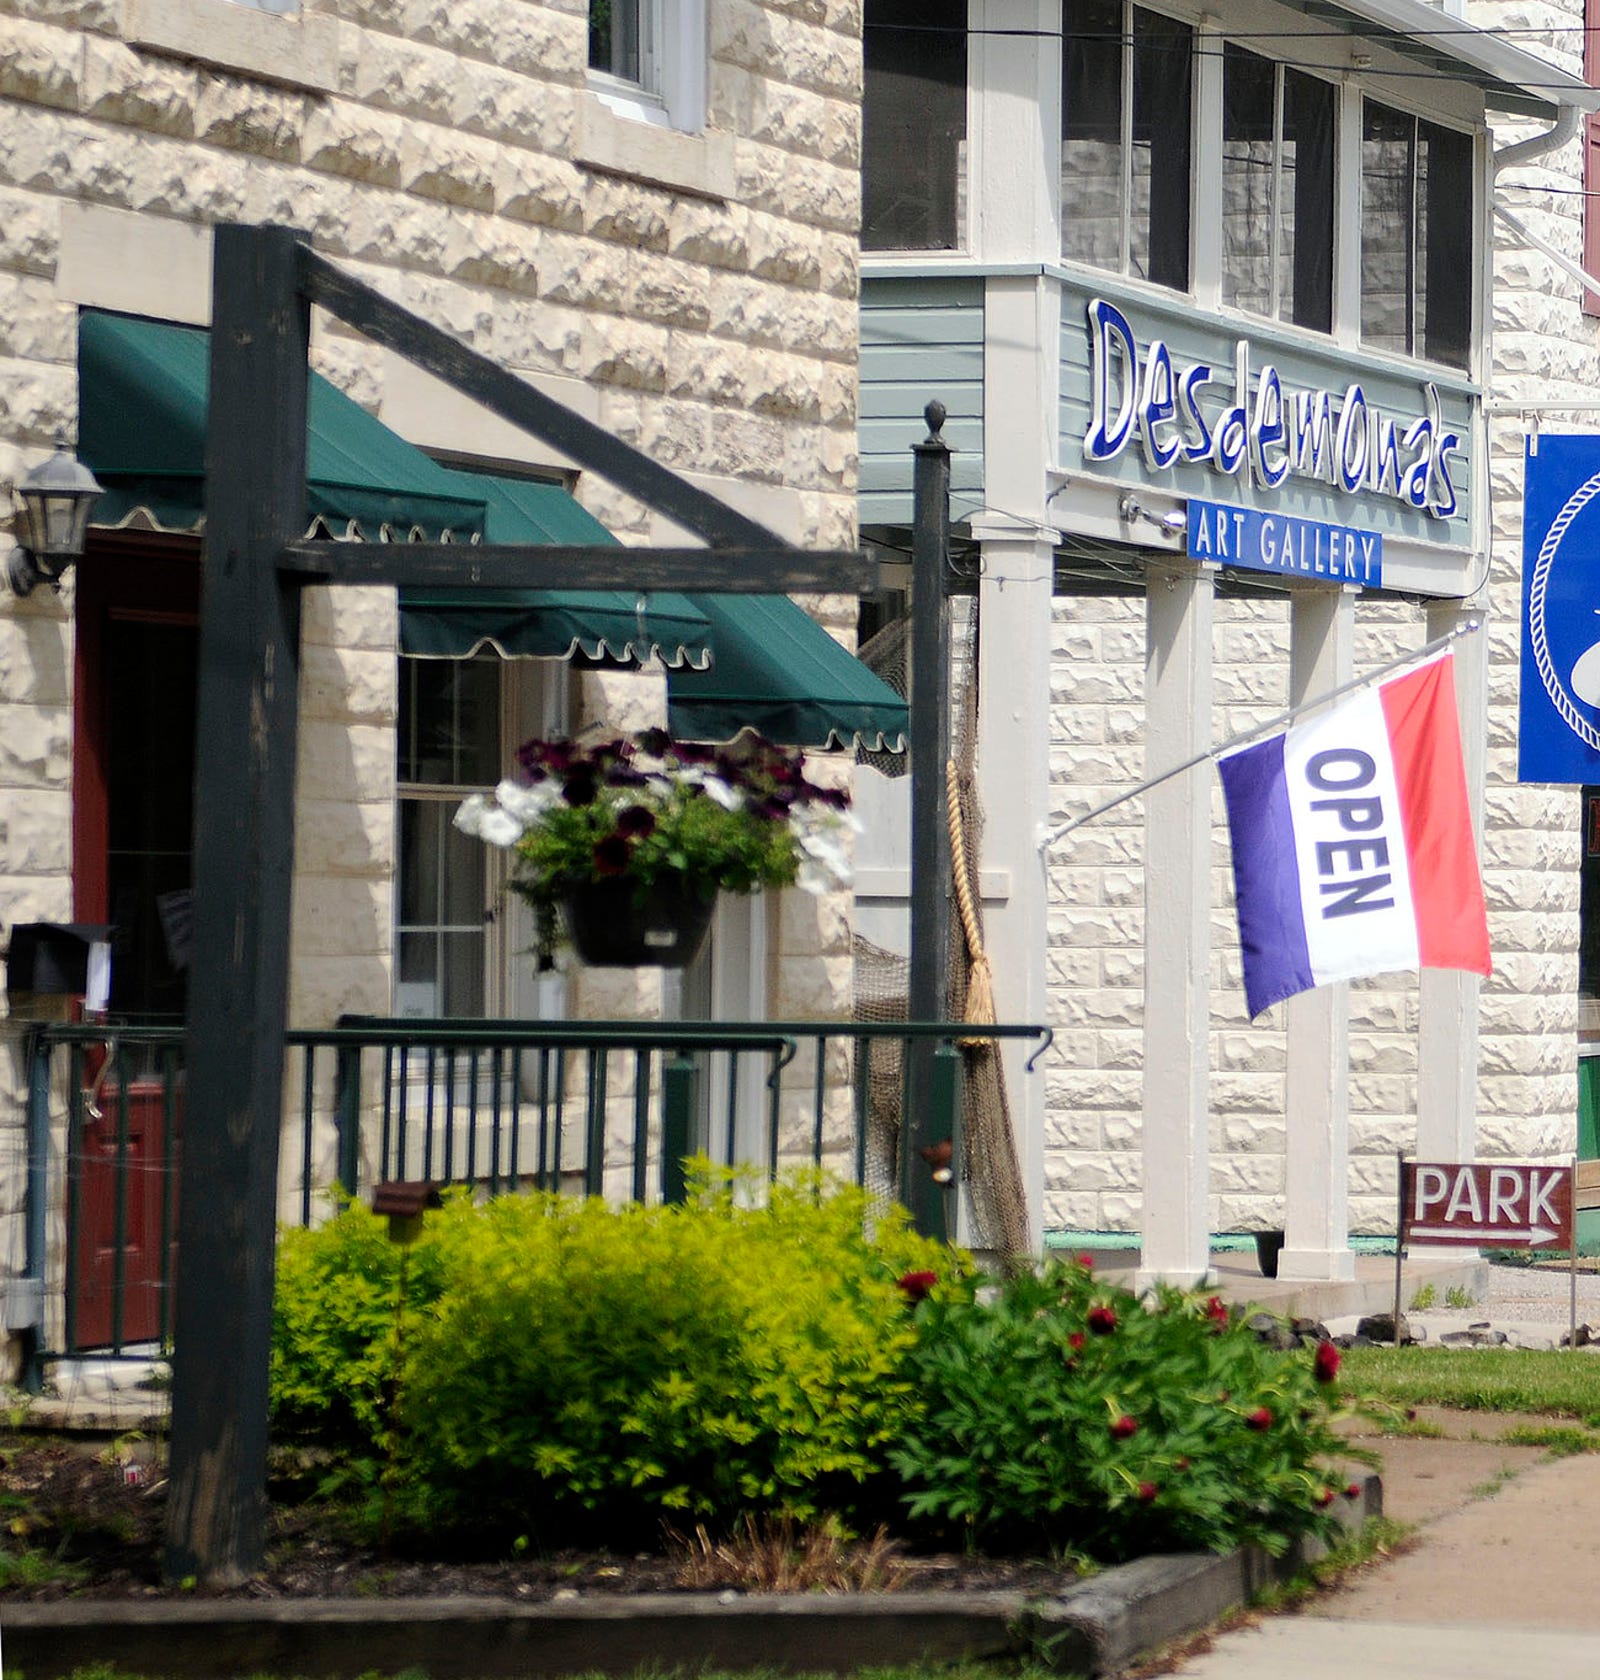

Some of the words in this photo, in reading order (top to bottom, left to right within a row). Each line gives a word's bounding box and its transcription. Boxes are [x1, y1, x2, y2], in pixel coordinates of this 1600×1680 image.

[1195, 506, 1245, 559] ART
[1260, 519, 1375, 581] GALLERY
[1304, 748, 1395, 920] OPEN
[1414, 1166, 1563, 1225] PARK
